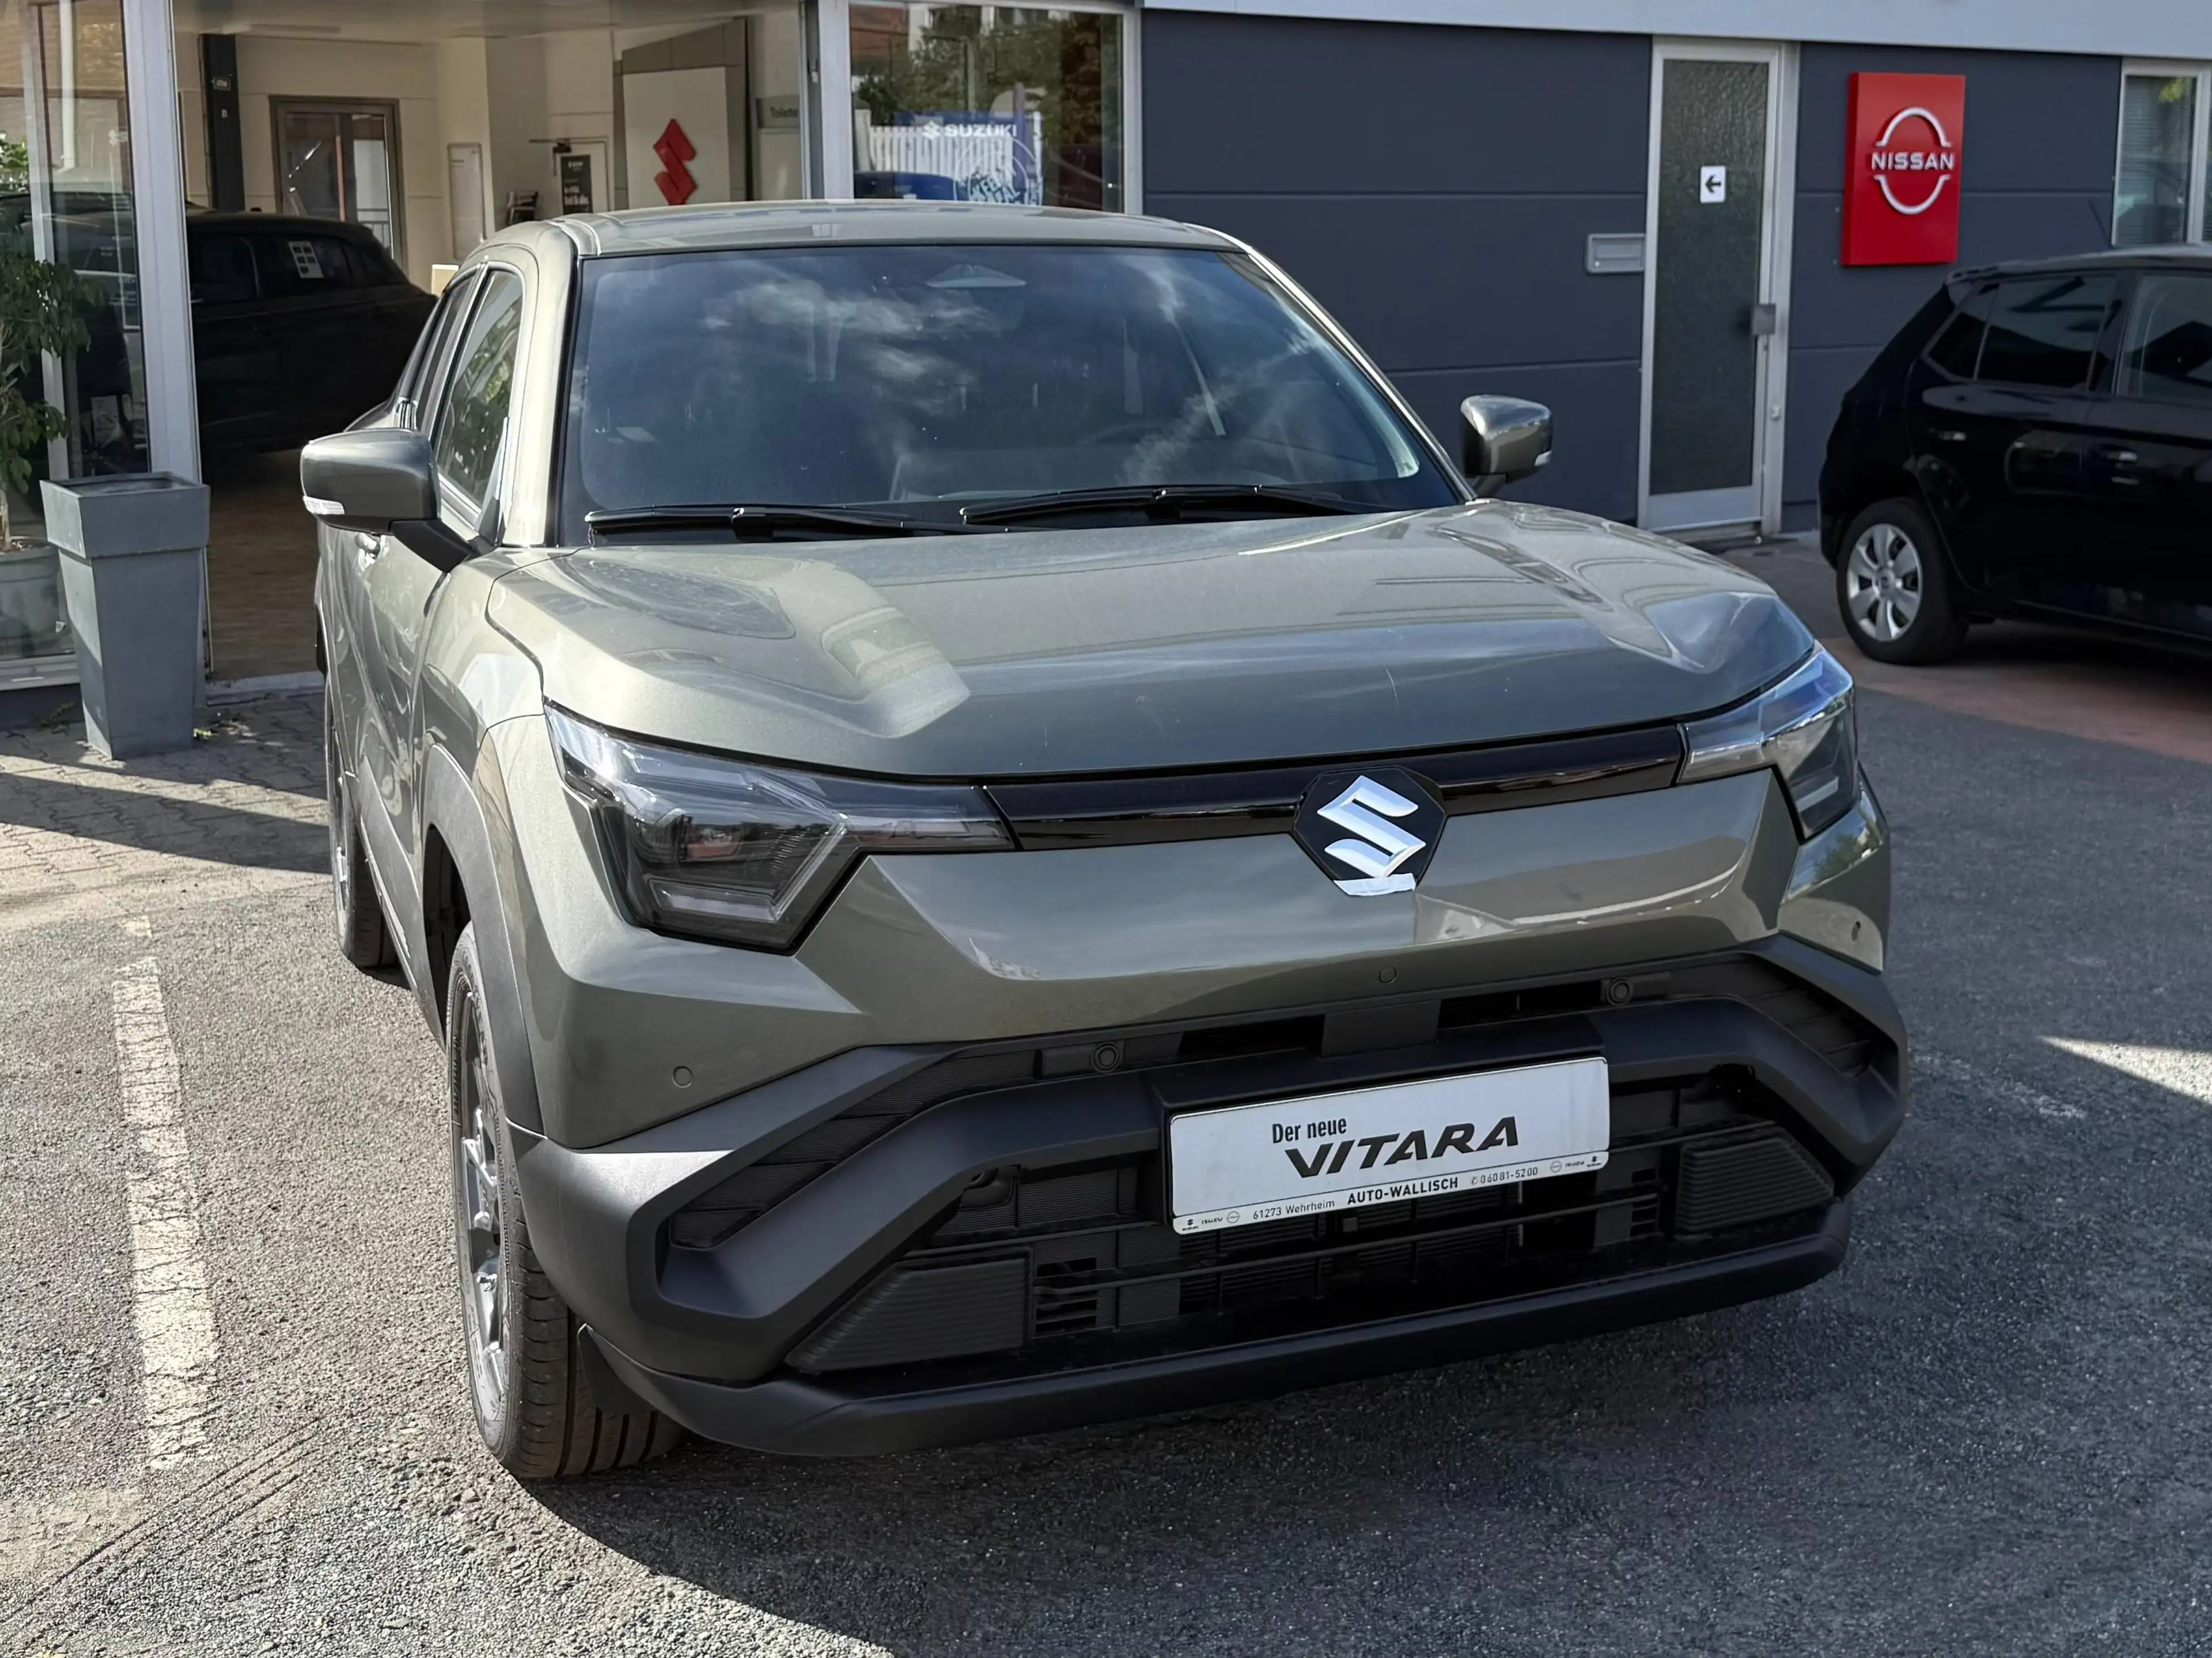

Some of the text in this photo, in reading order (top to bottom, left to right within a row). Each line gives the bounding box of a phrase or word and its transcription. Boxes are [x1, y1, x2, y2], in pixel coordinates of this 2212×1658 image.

[944, 123, 1017, 137] SUZUKI
[1872, 151, 1955, 171] NISSAN
[1271, 1118, 1347, 1144] Der neue
[1284, 1115, 1519, 1179] VITARA
[1253, 1206, 1282, 1220] 61273
[1285, 1200, 1335, 1214] Wehrheim
[1347, 1176, 1459, 1205] AUTO-WALLISCH
[1480, 1167, 1538, 1184] 06081-5200
